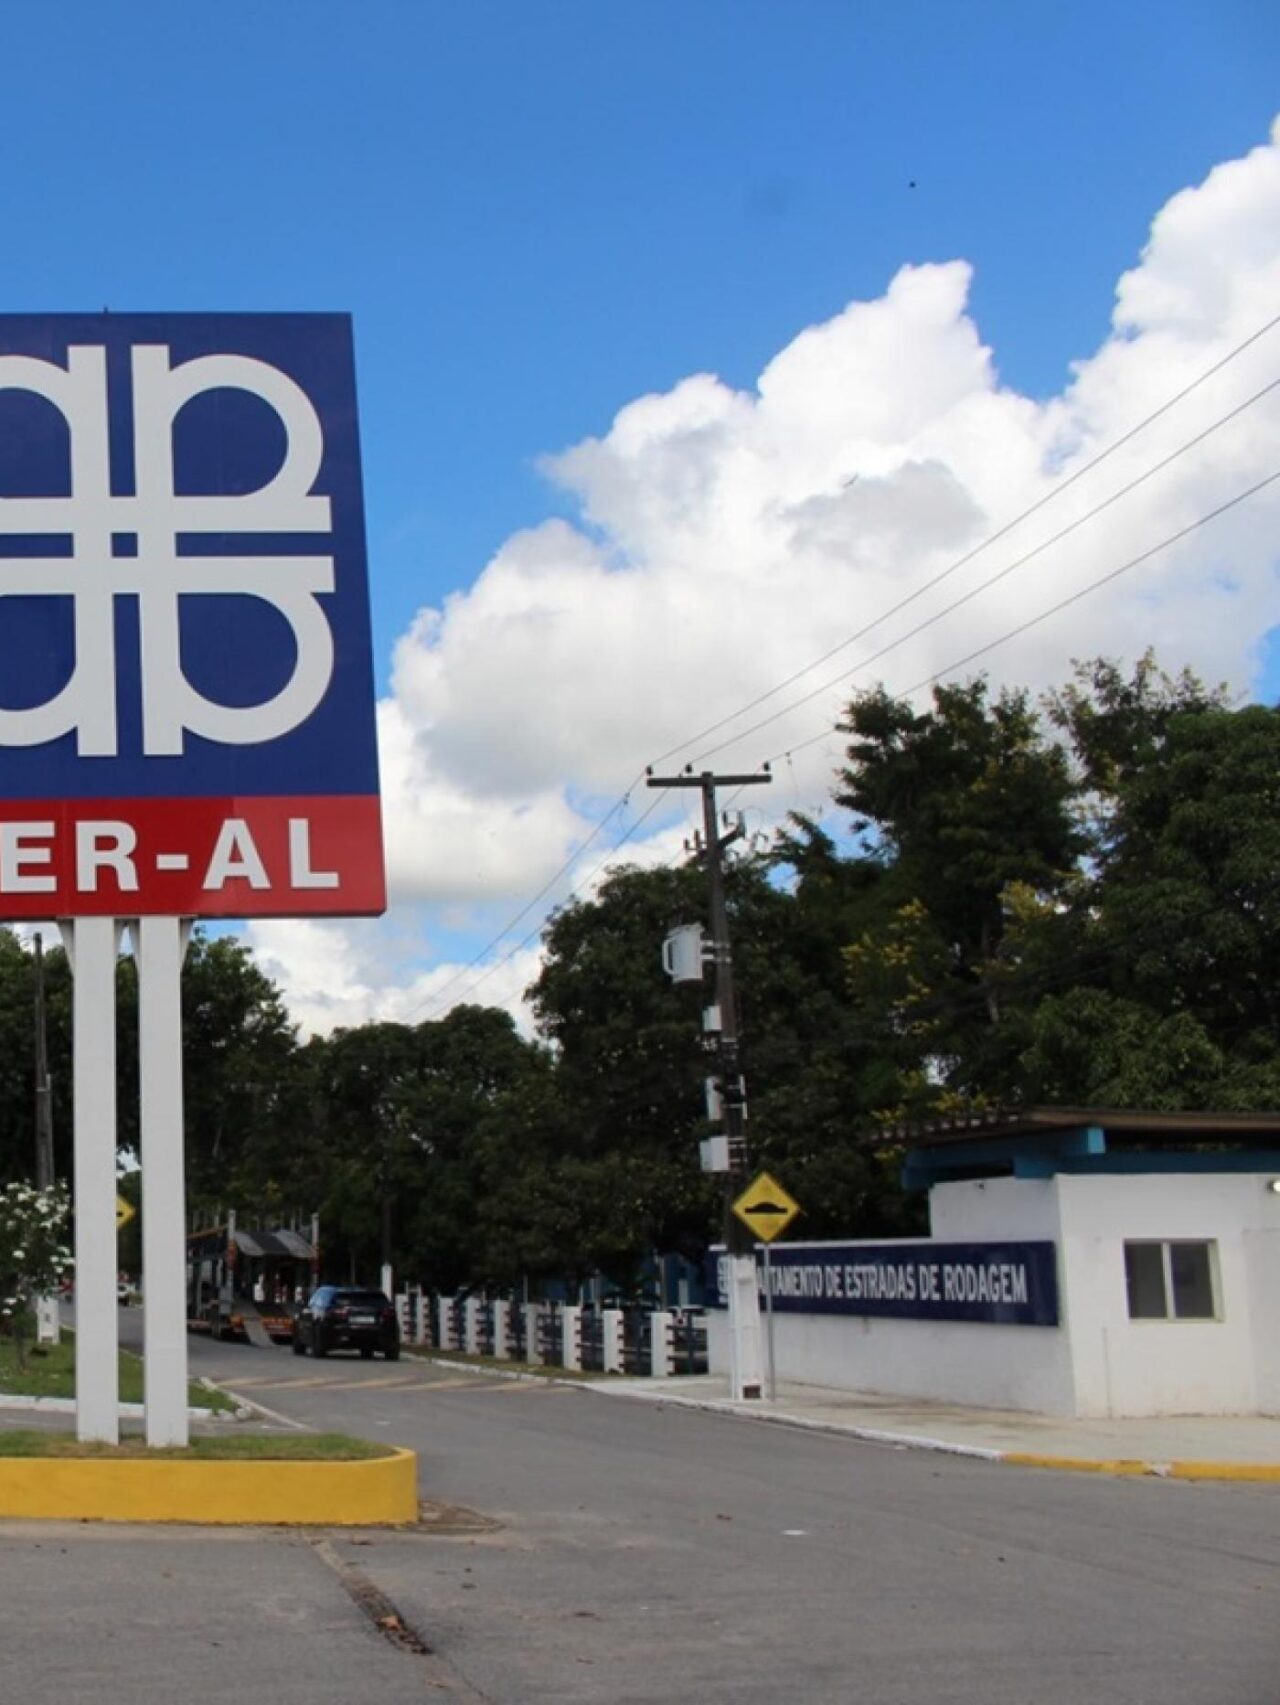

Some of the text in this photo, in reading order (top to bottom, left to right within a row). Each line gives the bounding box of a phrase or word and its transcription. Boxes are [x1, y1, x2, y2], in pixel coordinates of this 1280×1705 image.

[824, 1265, 844, 1297] DE
[844, 1264, 917, 1299] ESTRADAS
[918, 1264, 940, 1300] DE
[943, 1264, 1028, 1303] RODAGEM
